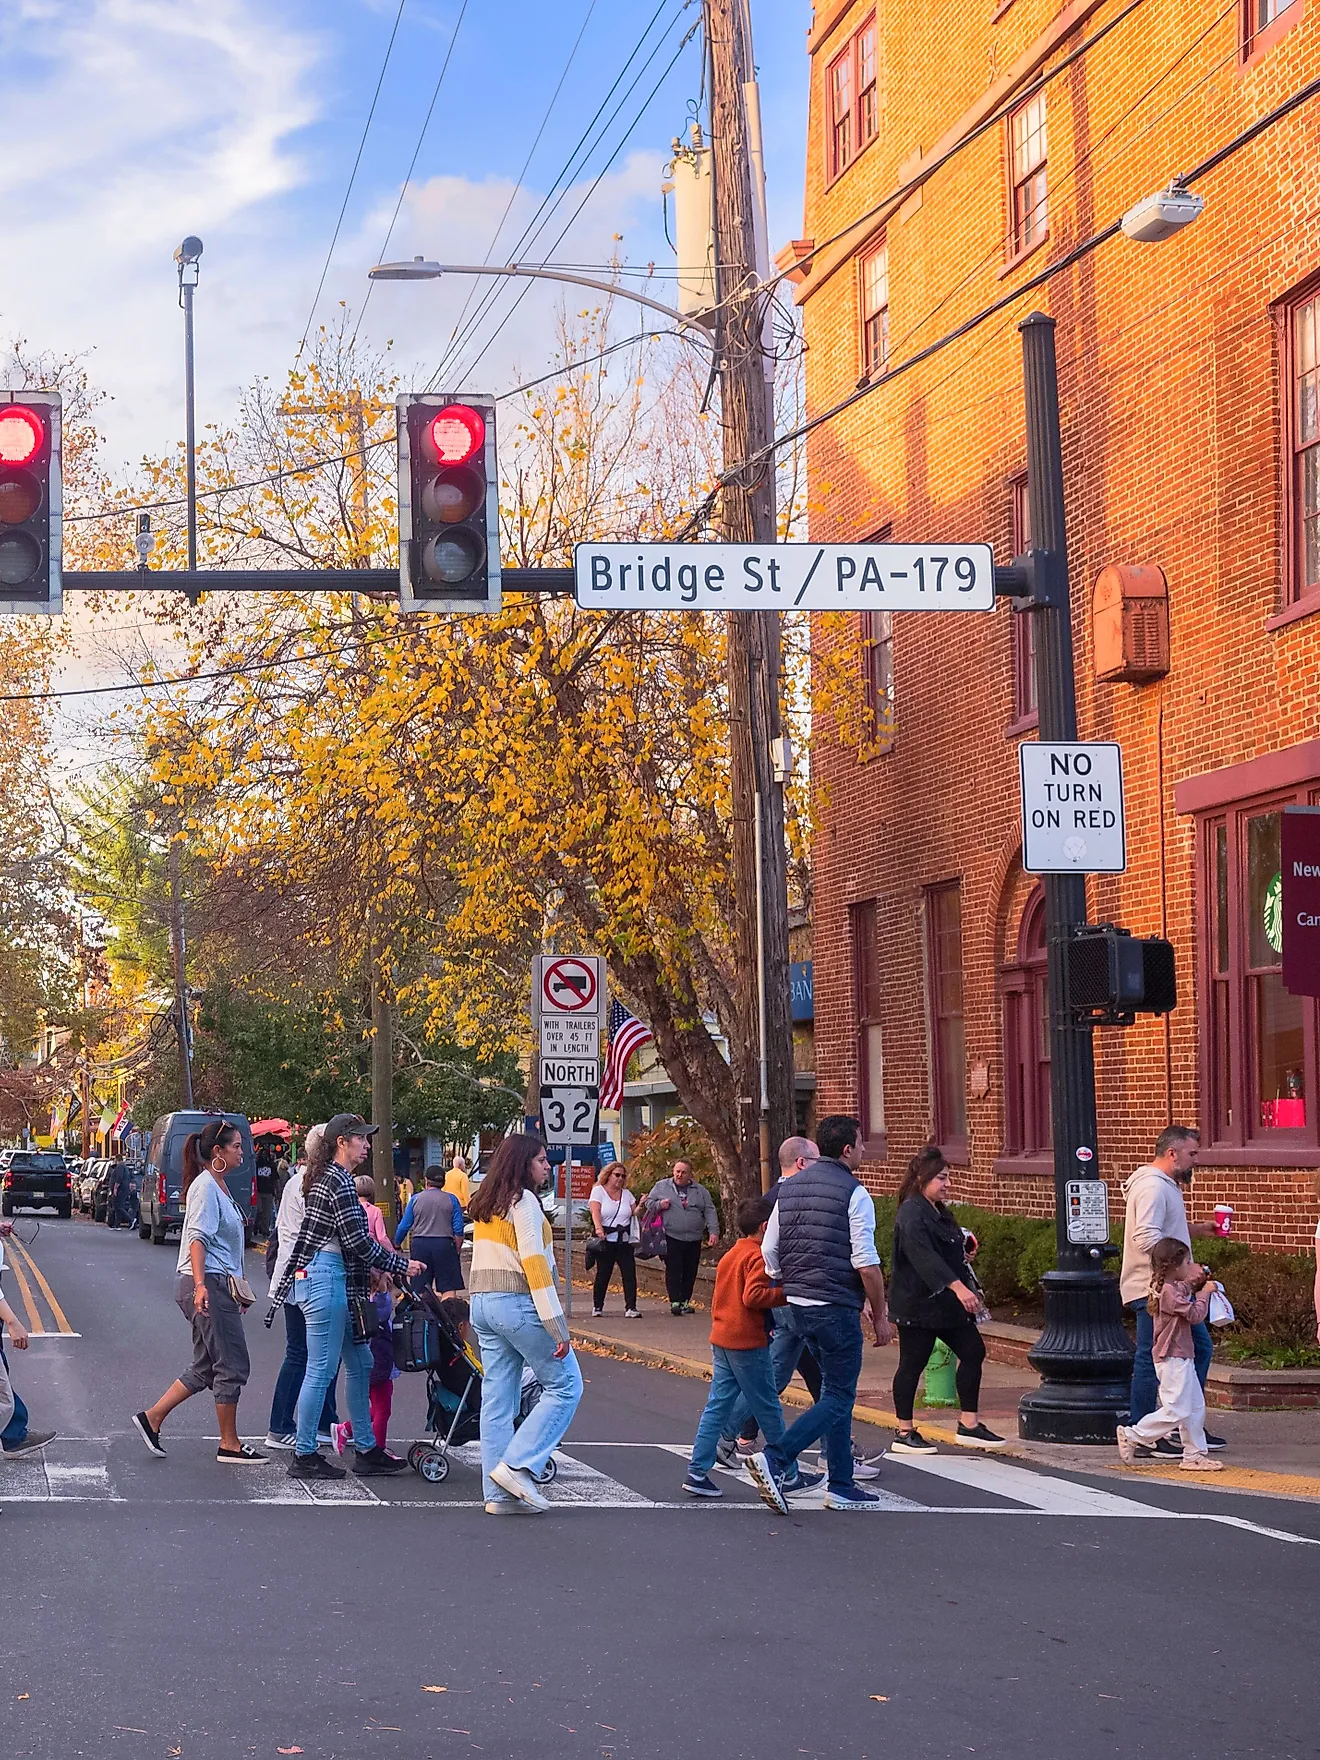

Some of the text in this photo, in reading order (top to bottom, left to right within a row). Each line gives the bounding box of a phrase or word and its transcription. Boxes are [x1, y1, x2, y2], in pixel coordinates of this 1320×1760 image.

[591, 556, 725, 602] Bridge
[743, 556, 781, 592] St
[837, 557, 977, 592] PA-179
[1050, 753, 1092, 776] NO
[1043, 783, 1102, 802] TURN
[1031, 809, 1116, 828] ON RED
[544, 1020, 596, 1031] WITH TRAILERS
[546, 1032, 593, 1042] OVER 45 FT
[550, 1043, 589, 1053] IN LENGTH
[544, 1062, 595, 1082] NORTH
[547, 1100, 591, 1133] 32
